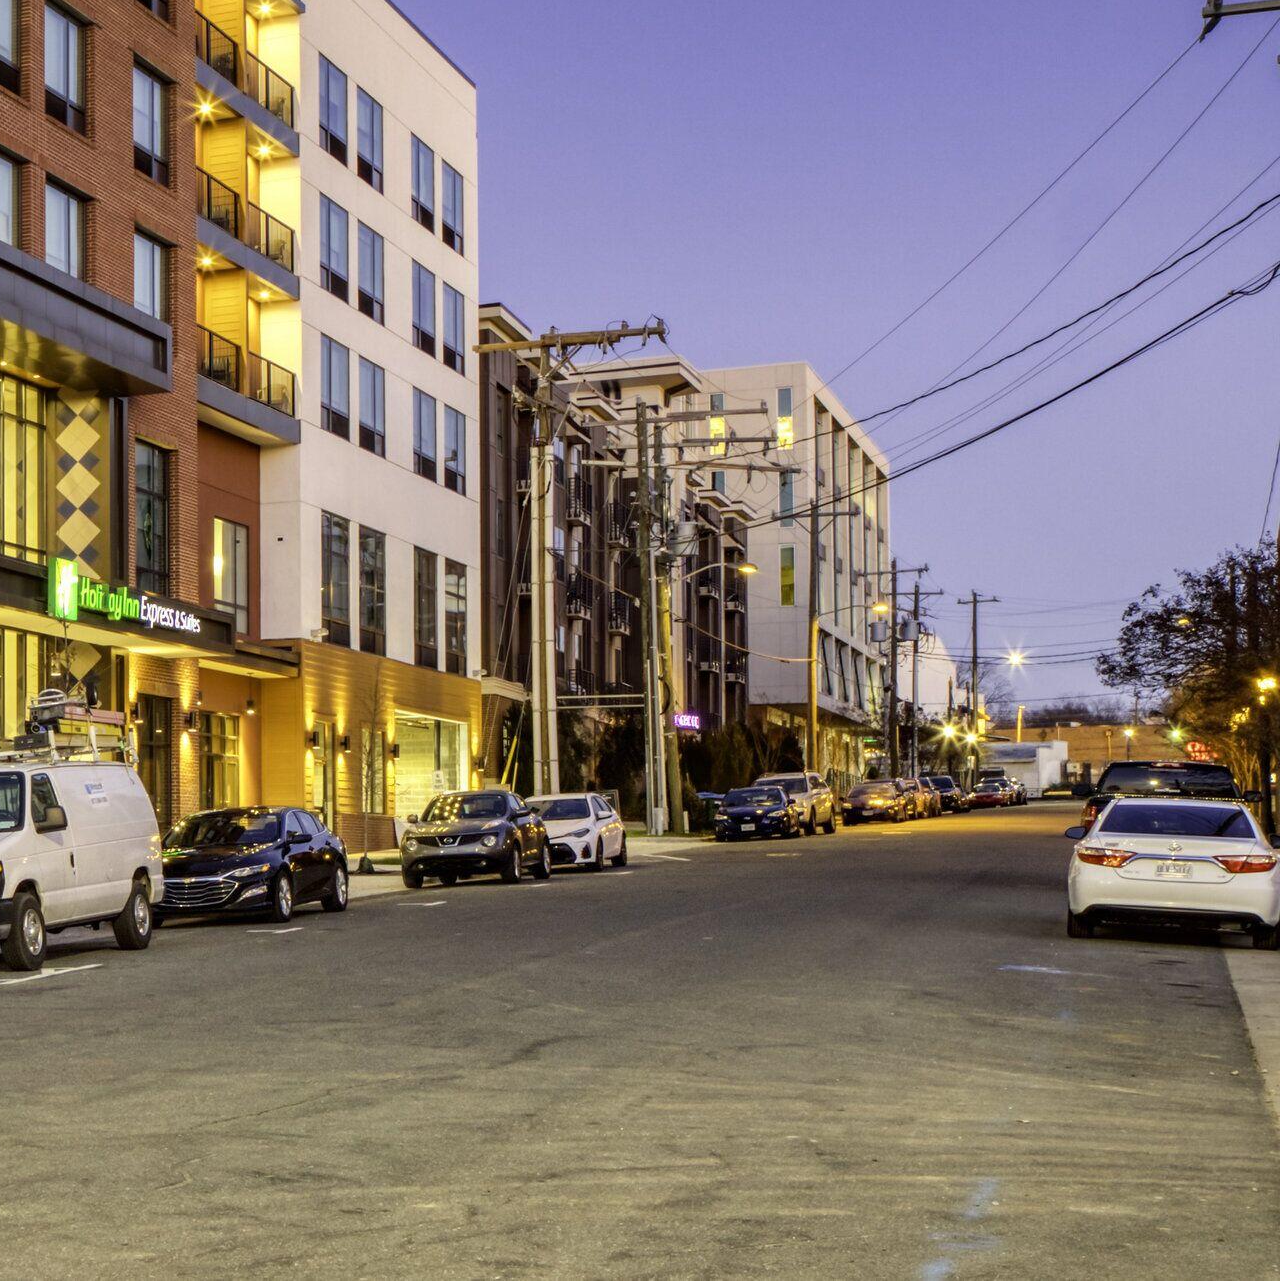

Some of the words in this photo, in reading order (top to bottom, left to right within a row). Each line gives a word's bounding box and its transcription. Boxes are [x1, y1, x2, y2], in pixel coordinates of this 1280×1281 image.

[80, 576, 122, 620] Holiay
[122, 586, 140, 618] Inn
[140, 595, 175, 629] Express
